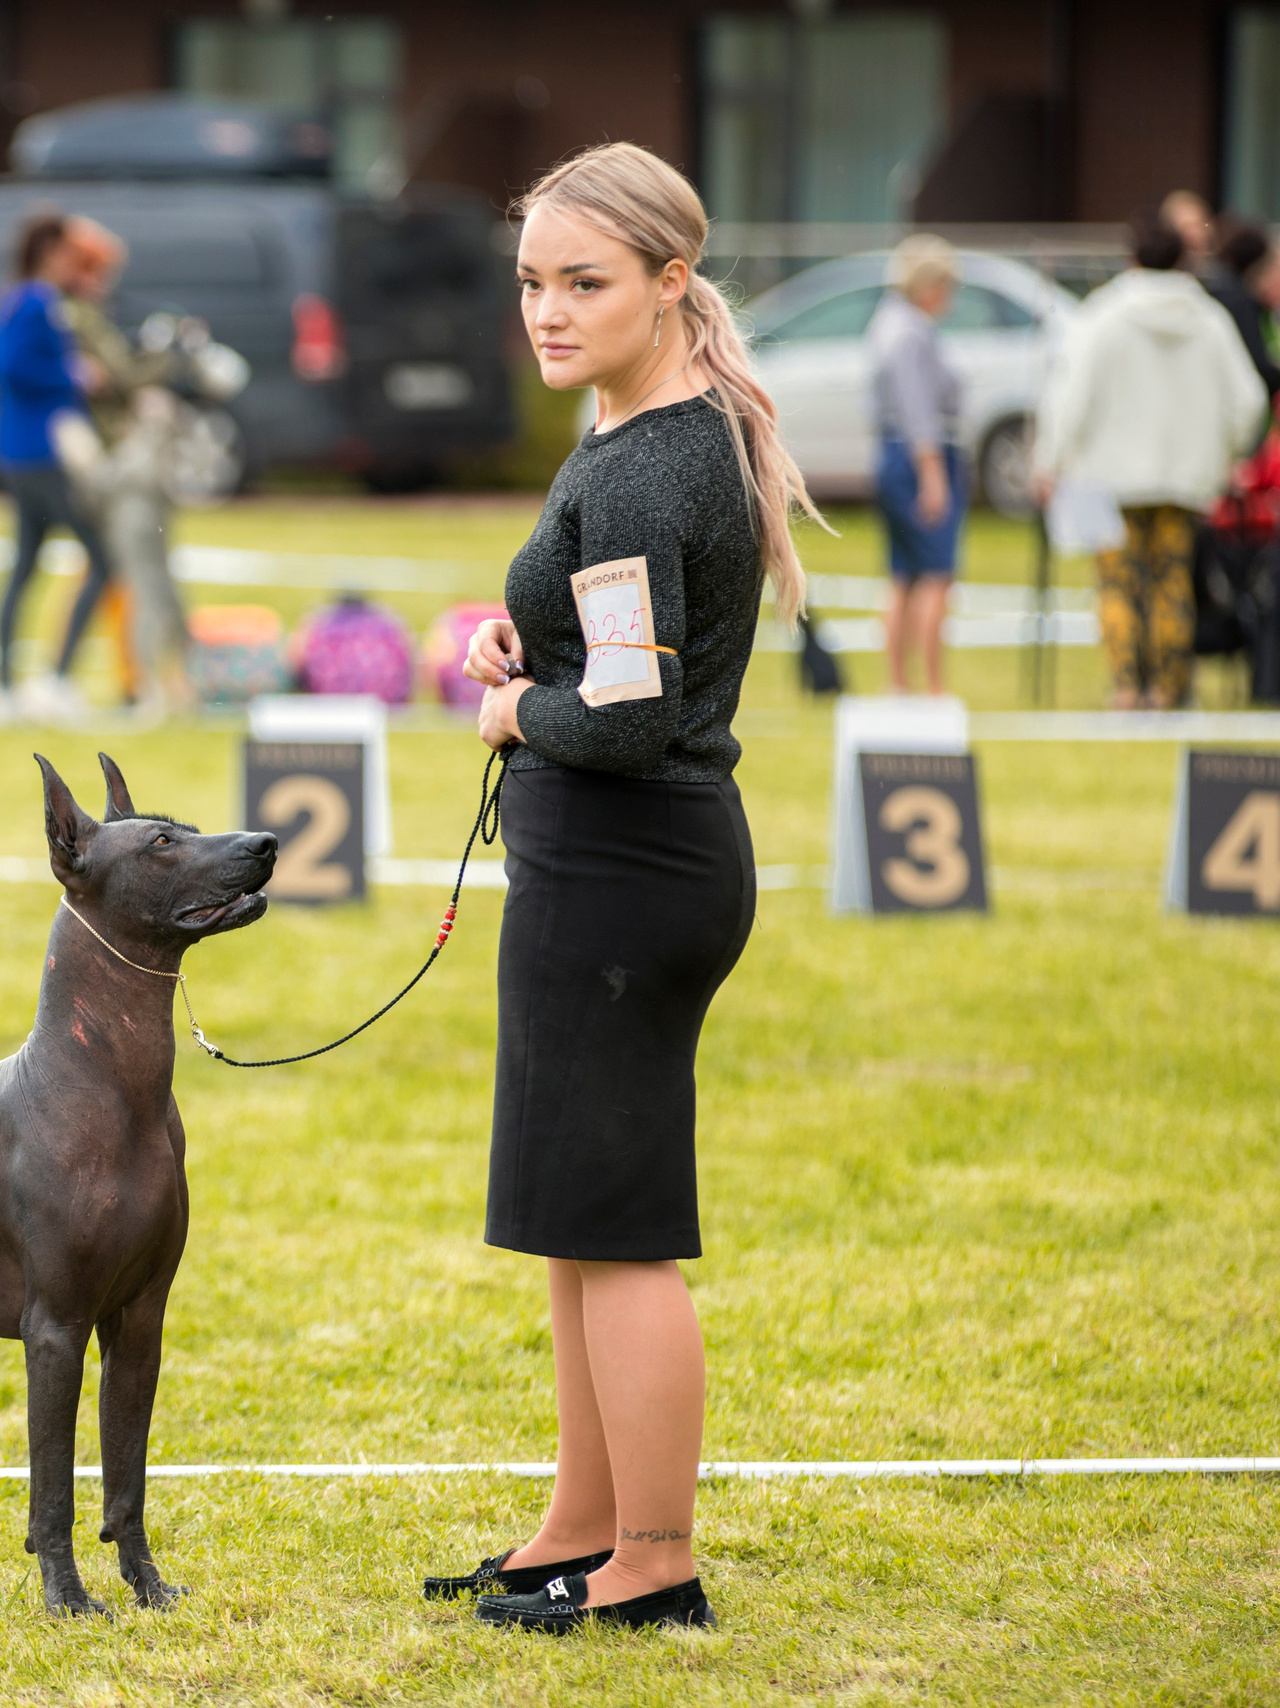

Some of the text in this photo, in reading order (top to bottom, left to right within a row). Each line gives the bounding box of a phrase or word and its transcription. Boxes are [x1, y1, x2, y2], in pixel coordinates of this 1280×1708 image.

[258, 774, 352, 899] 2
[878, 784, 970, 907] 3
[1202, 788, 1280, 911] 4
